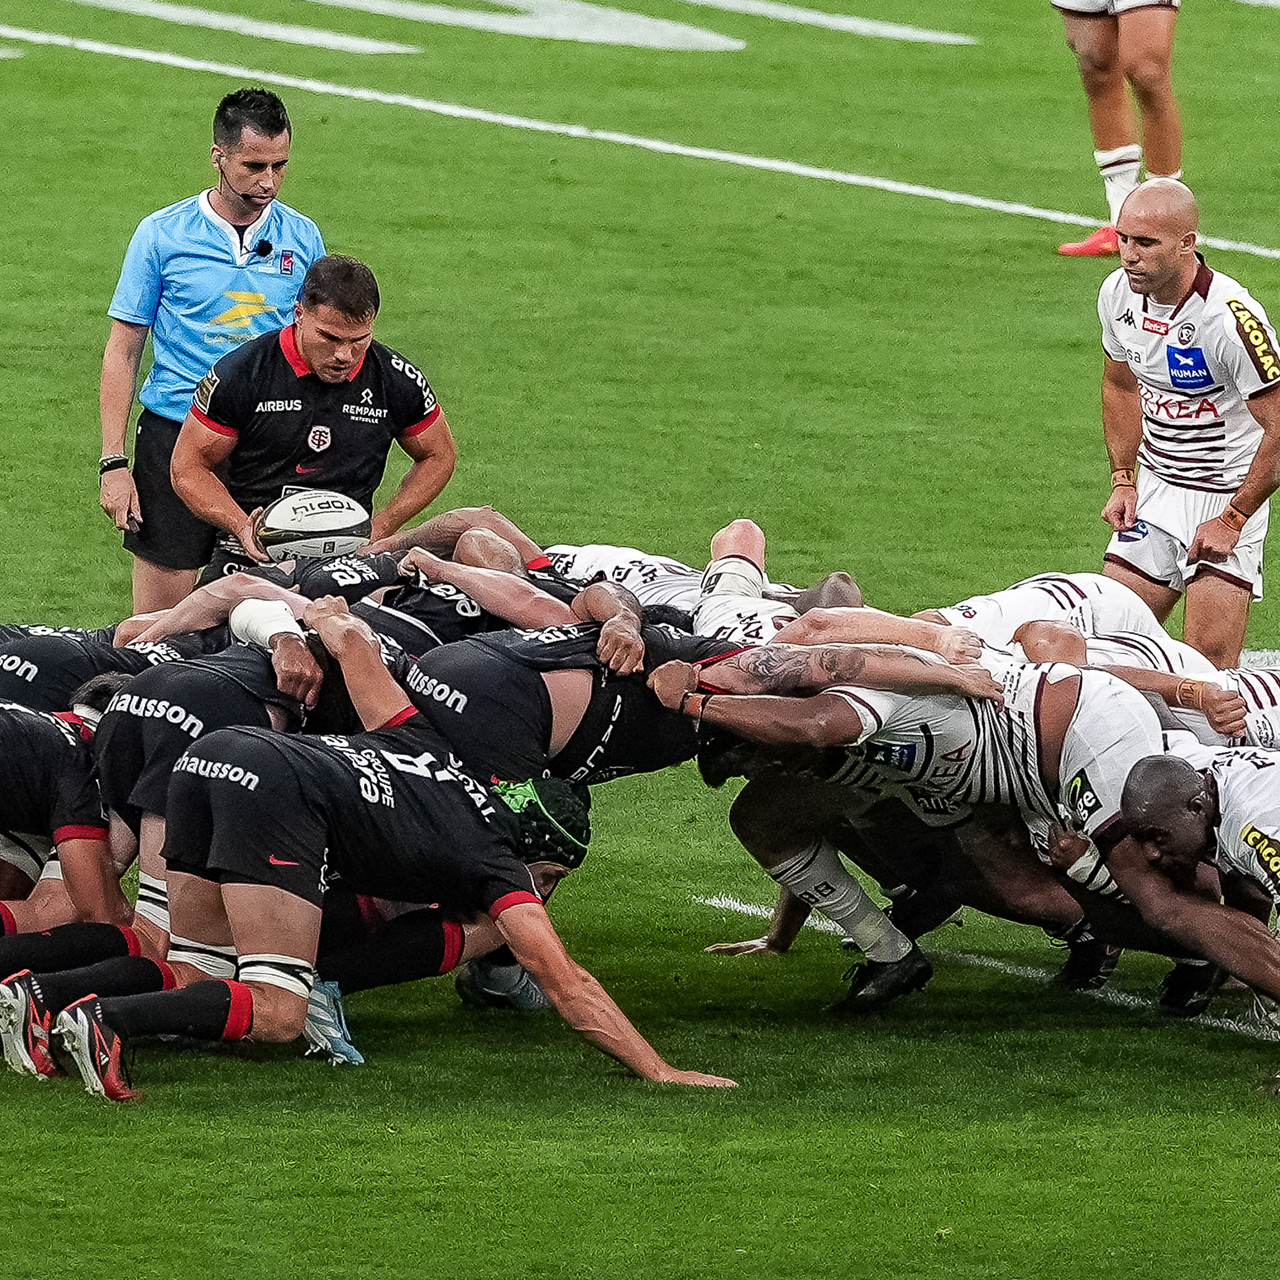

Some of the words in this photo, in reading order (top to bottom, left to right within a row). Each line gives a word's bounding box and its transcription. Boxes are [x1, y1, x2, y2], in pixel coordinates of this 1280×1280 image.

[391, 354, 437, 416] actual
[1170, 368, 1208, 379] HUMAN
[255, 399, 302, 413] AIRBUS
[342, 404, 388, 419] REMPART
[1137, 383, 1219, 419] RKEA
[172, 750, 260, 792] chausson
[360, 749, 395, 809] GROUPE
